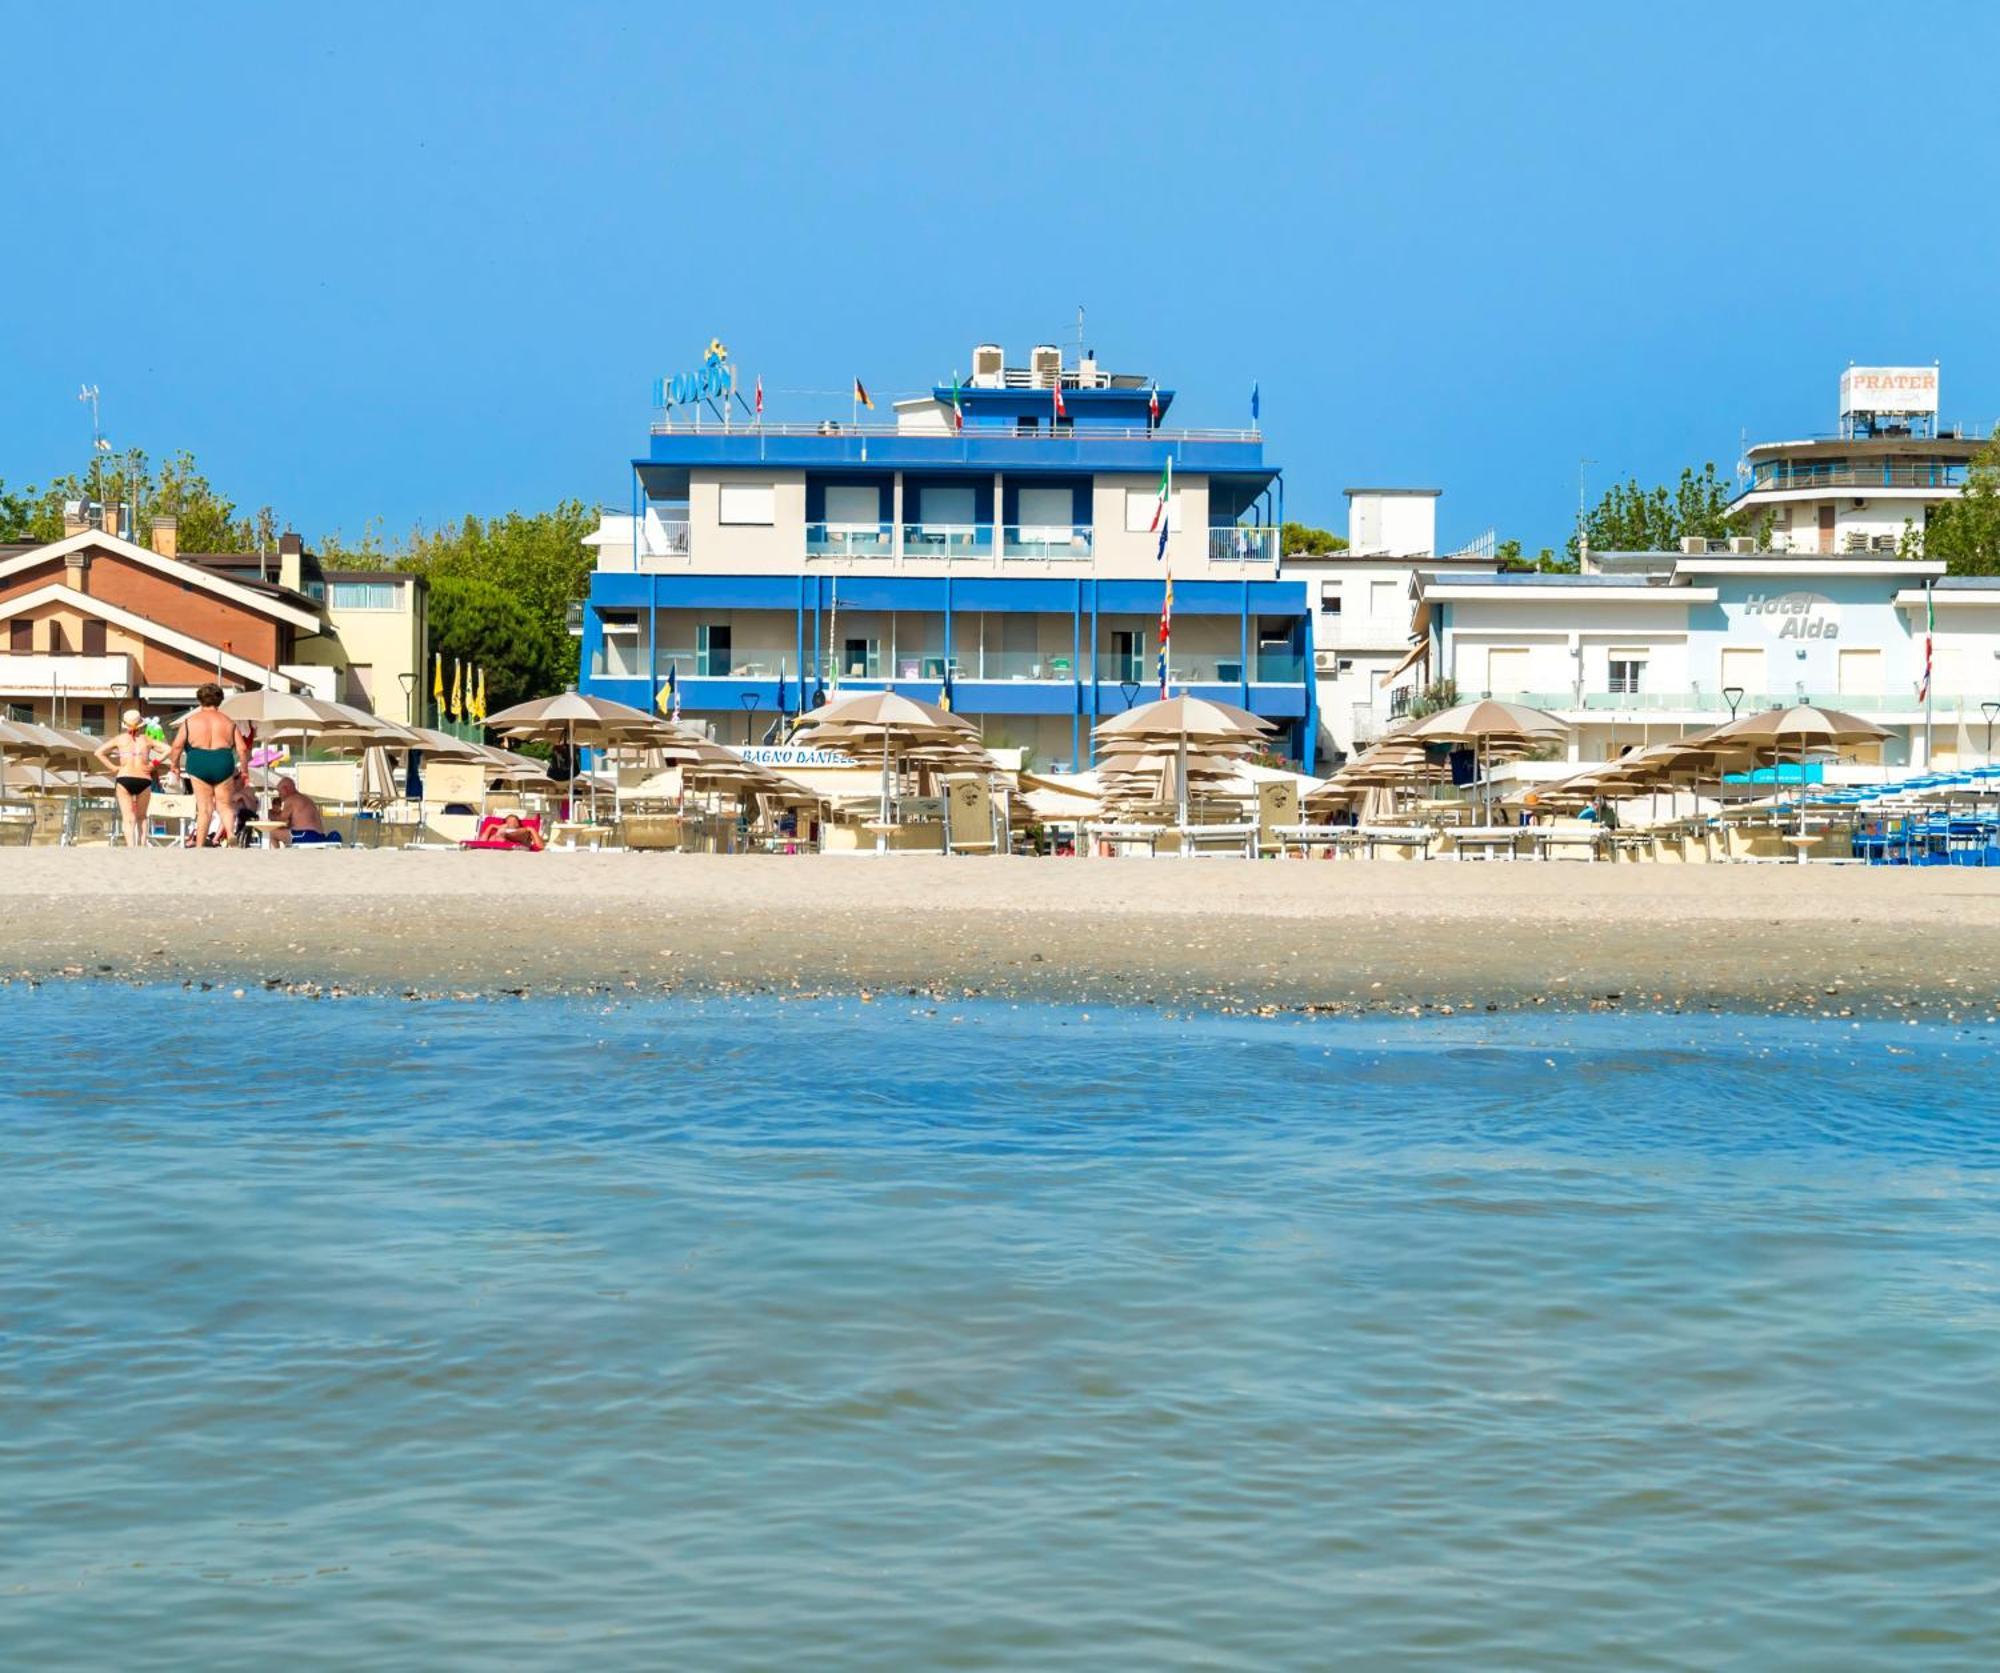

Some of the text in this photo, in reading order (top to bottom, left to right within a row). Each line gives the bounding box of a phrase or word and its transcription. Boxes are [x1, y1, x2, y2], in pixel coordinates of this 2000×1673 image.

[1853, 375, 1936, 390] PRATER
[1744, 593, 1814, 616] Hotel
[1779, 616, 1839, 640] Alda
[742, 750, 793, 763] BAGNO
